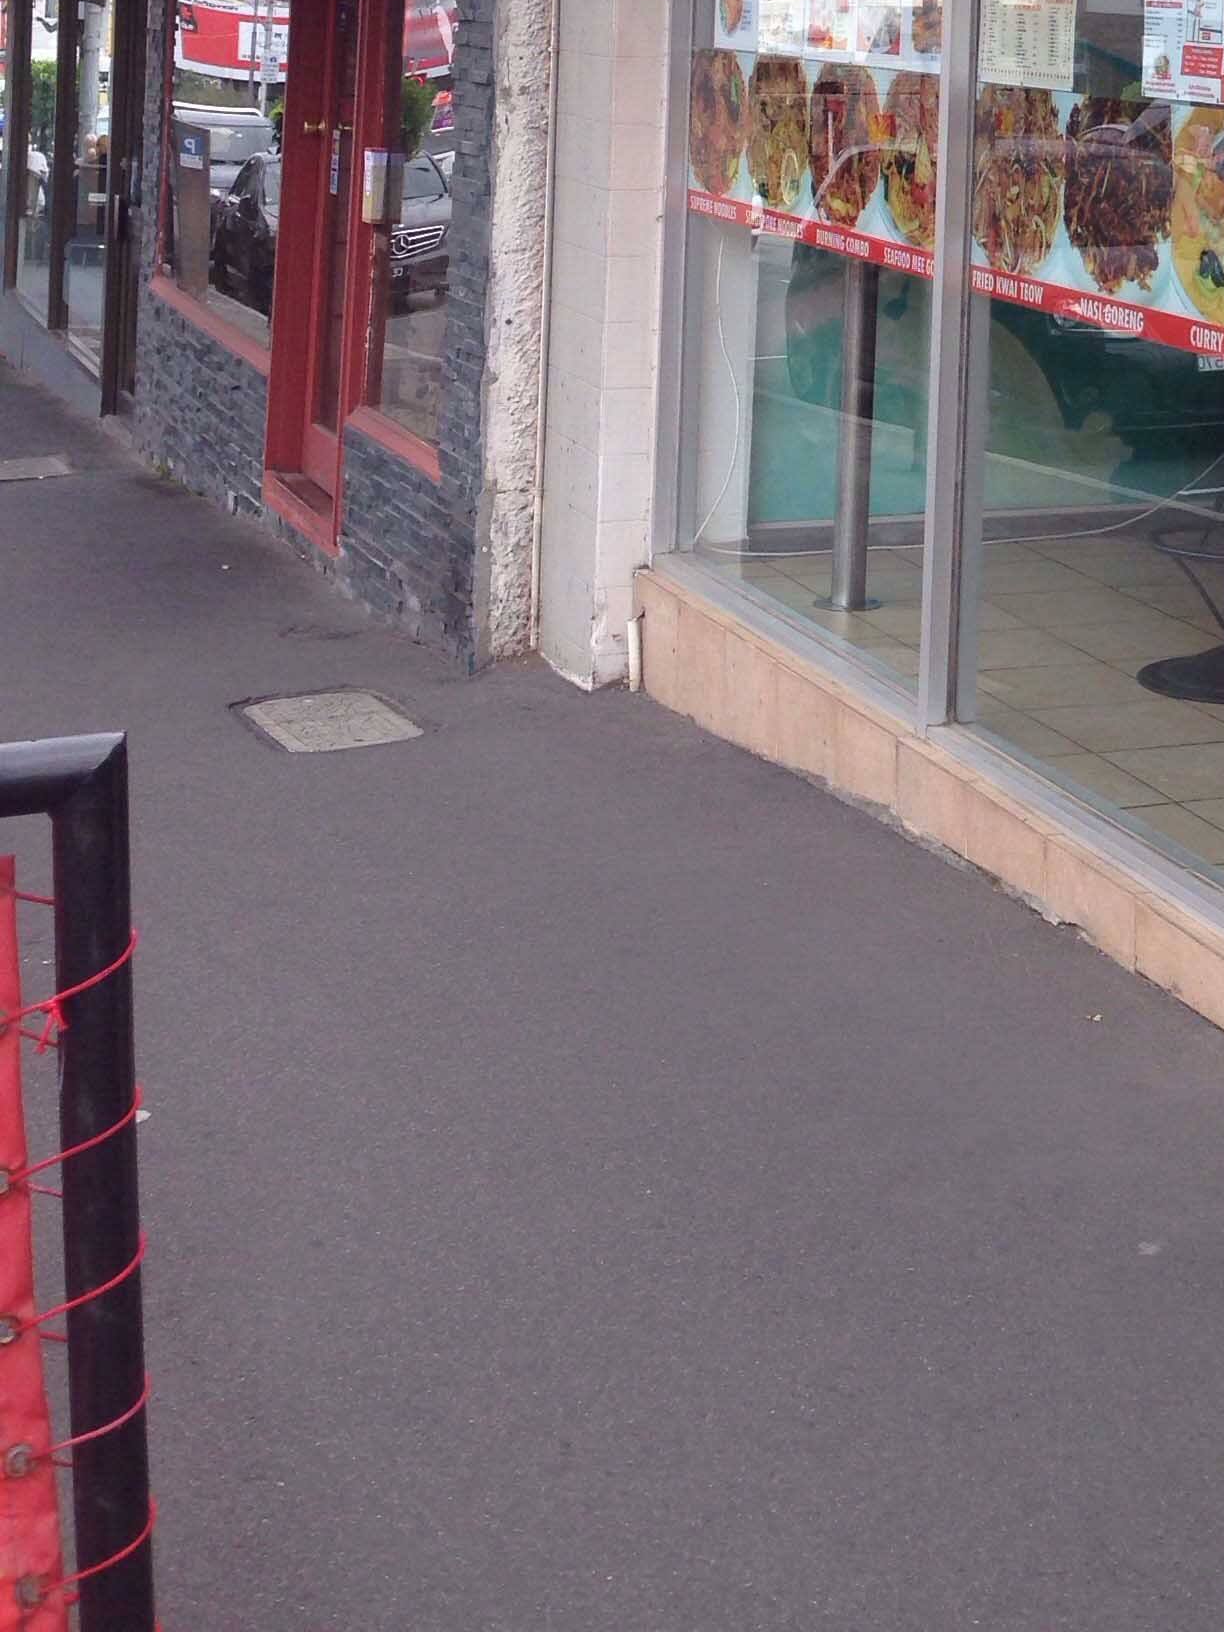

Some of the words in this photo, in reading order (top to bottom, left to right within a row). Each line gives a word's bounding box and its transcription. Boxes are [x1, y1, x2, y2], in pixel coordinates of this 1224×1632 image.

[713, 201, 737, 221] NOODLES
[816, 228, 845, 251] BURNING
[846, 236, 870, 258] COMBO
[883, 246, 911, 269] SEAFOOD
[972, 270, 994, 292] FRIED
[994, 275, 1018, 298] KWAI
[1019, 282, 1044, 305] TEOW
[1079, 297, 1103, 321] NASI
[1102, 303, 1145, 331] GORENG
[1190, 325, 1224, 352] CURRY
